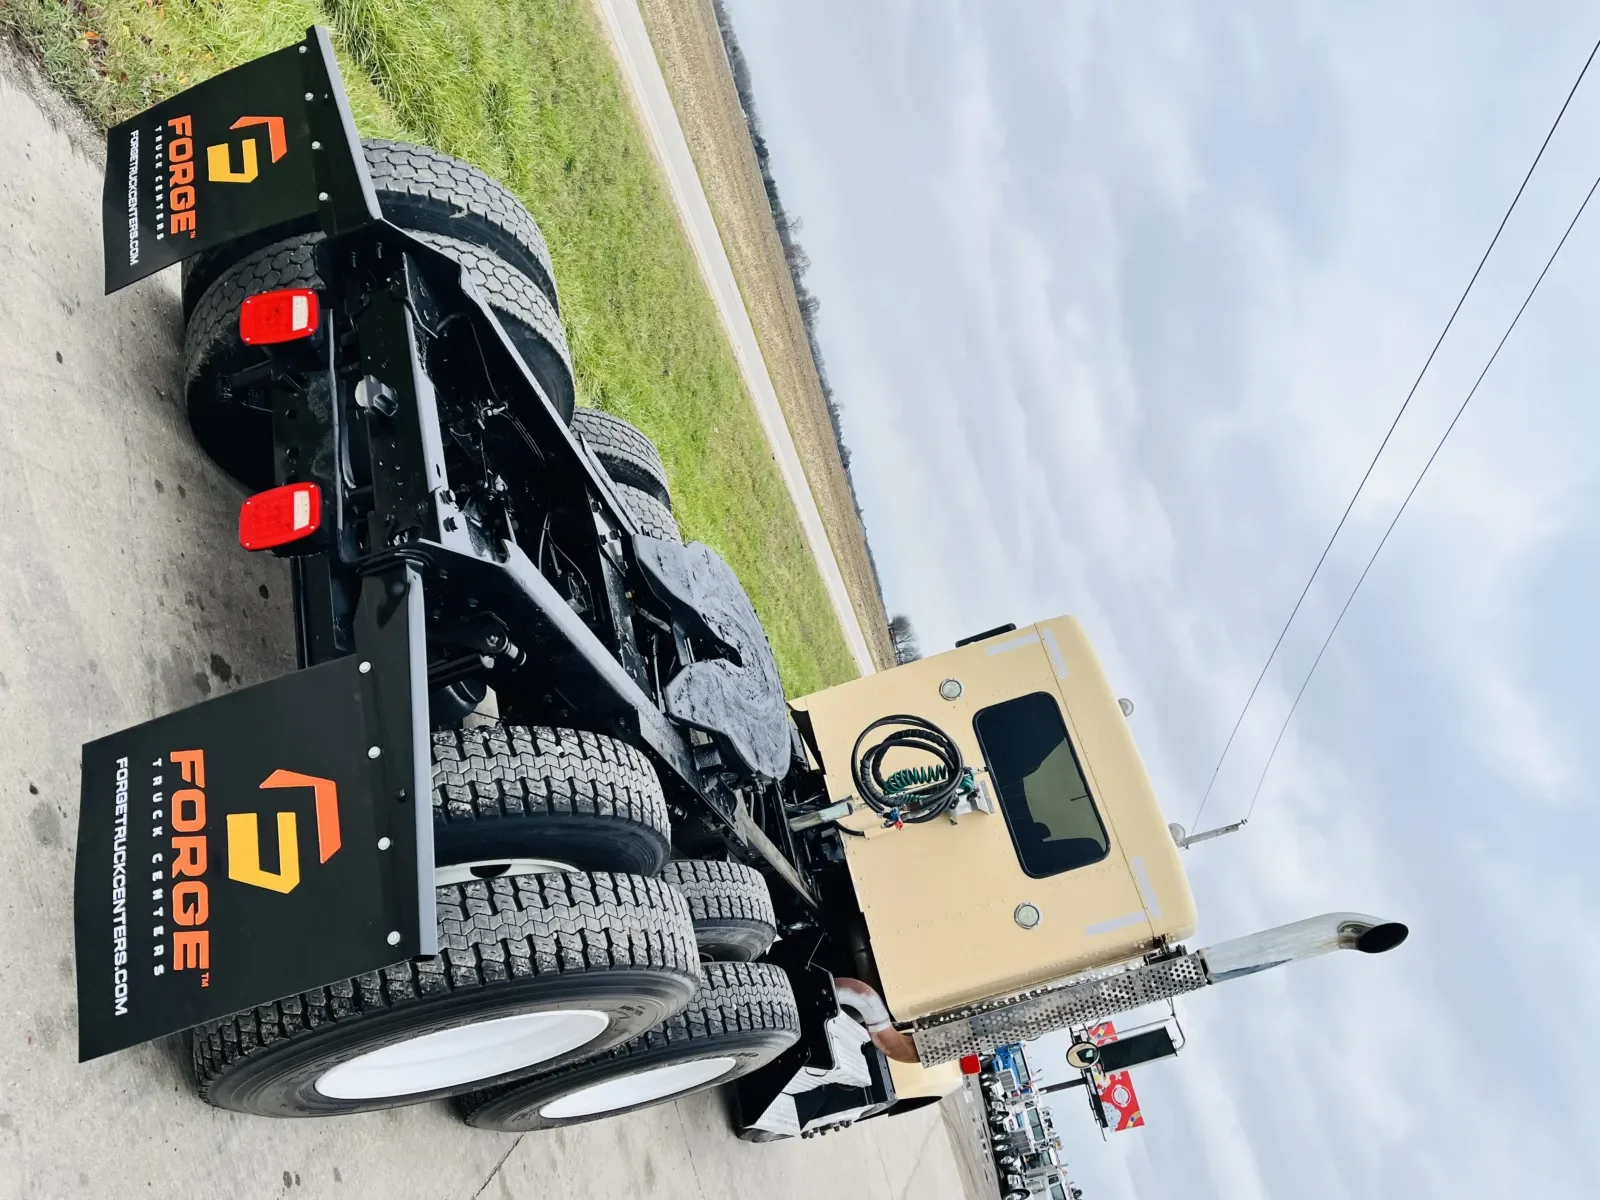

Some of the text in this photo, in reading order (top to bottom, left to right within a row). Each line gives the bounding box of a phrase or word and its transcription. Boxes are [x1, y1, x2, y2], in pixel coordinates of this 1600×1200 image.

[128, 130, 139, 266] FORGETRUCKCENTERS.COM
[155, 176, 164, 240] CENTERS
[168, 115, 195, 234] FORGE
[113, 757, 128, 1016] FORGETRUCKCENTERS.COM
[152, 758, 164, 976] TRUCK CENTERS
[170, 750, 209, 970] FORGE
